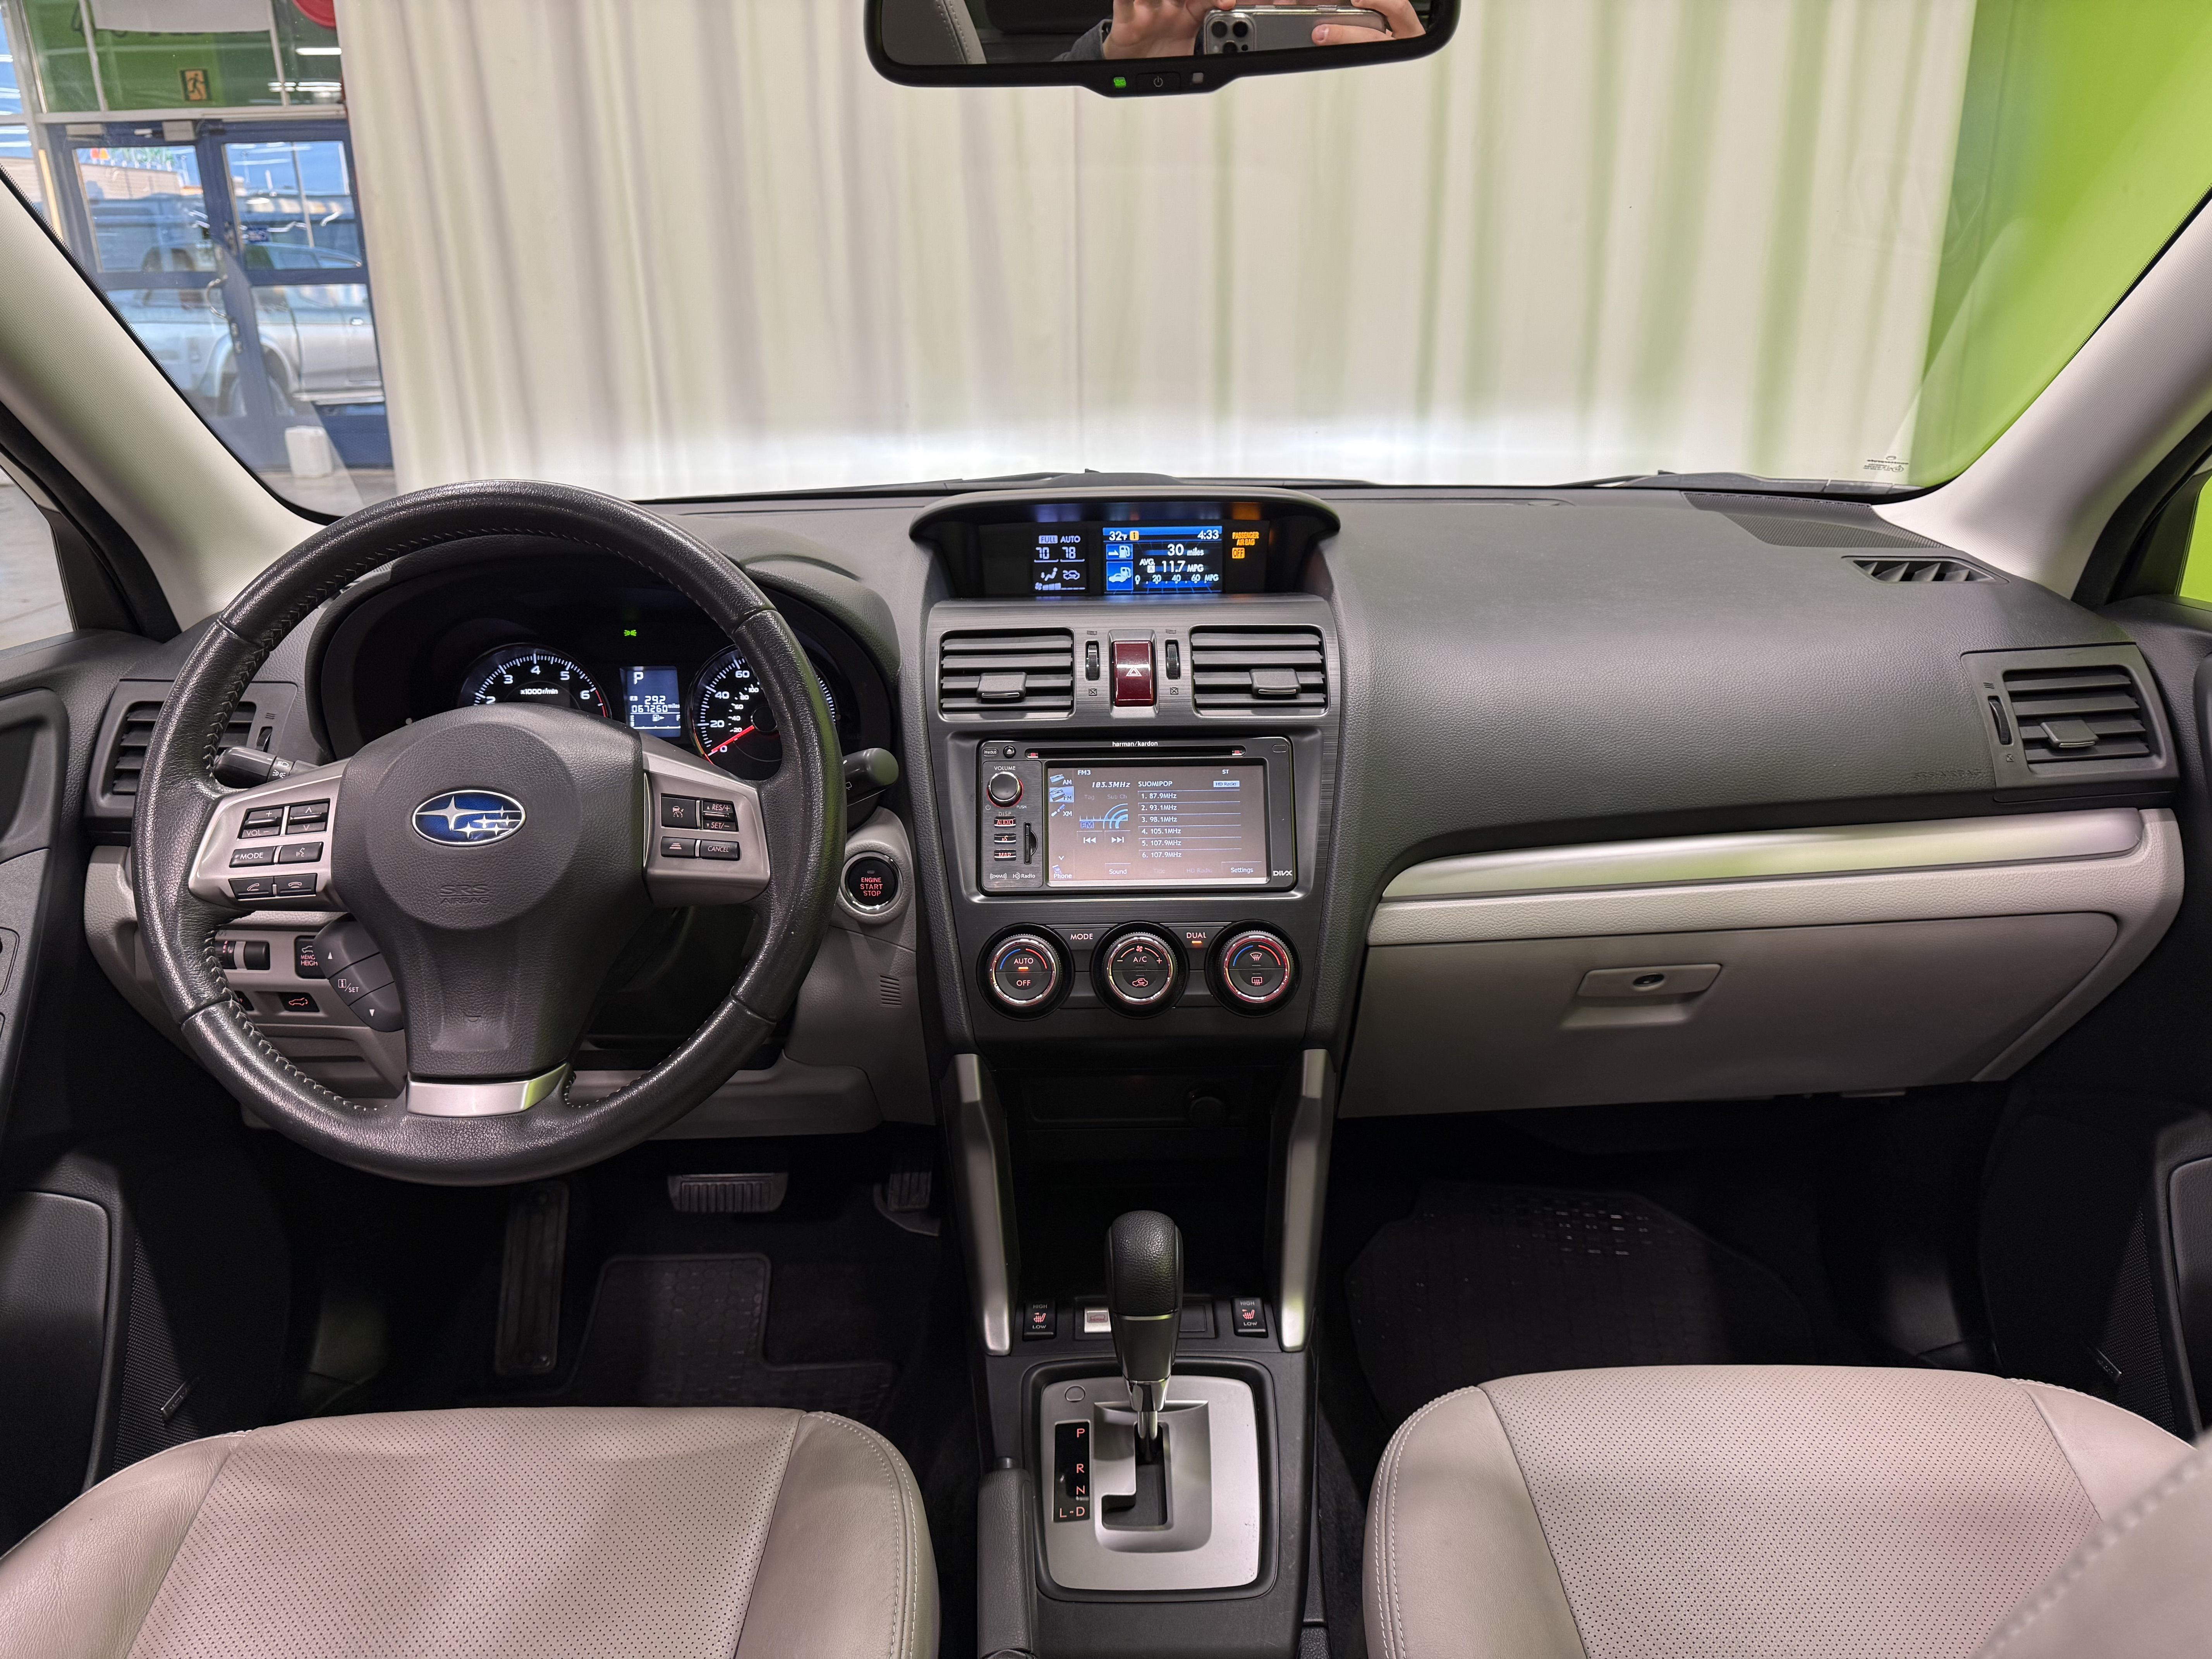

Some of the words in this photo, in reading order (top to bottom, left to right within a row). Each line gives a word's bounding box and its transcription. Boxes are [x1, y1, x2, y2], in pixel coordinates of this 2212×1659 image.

[1197, 529, 1219, 539] 4:33
[1036, 547, 1049, 559] 70
[1062, 546, 1076, 559] 78
[1167, 544, 1184, 556] 30
[1187, 547, 1204, 556] miles
[1233, 549, 1244, 558] OFF
[1162, 560, 1185, 572] 11.7
[1187, 564, 1204, 572] MPG
[530, 665, 541, 675] 4
[503, 675, 513, 684] 3
[560, 671, 570, 680] 5
[634, 672, 644, 685] P
[580, 690, 590, 700] 6
[631, 704, 668, 713] 067260
[440, 884, 489, 895] SRS
[1077, 1428, 1085, 1437] P
[1076, 1464, 1085, 1473] R
[1076, 1485, 1085, 1495] N
